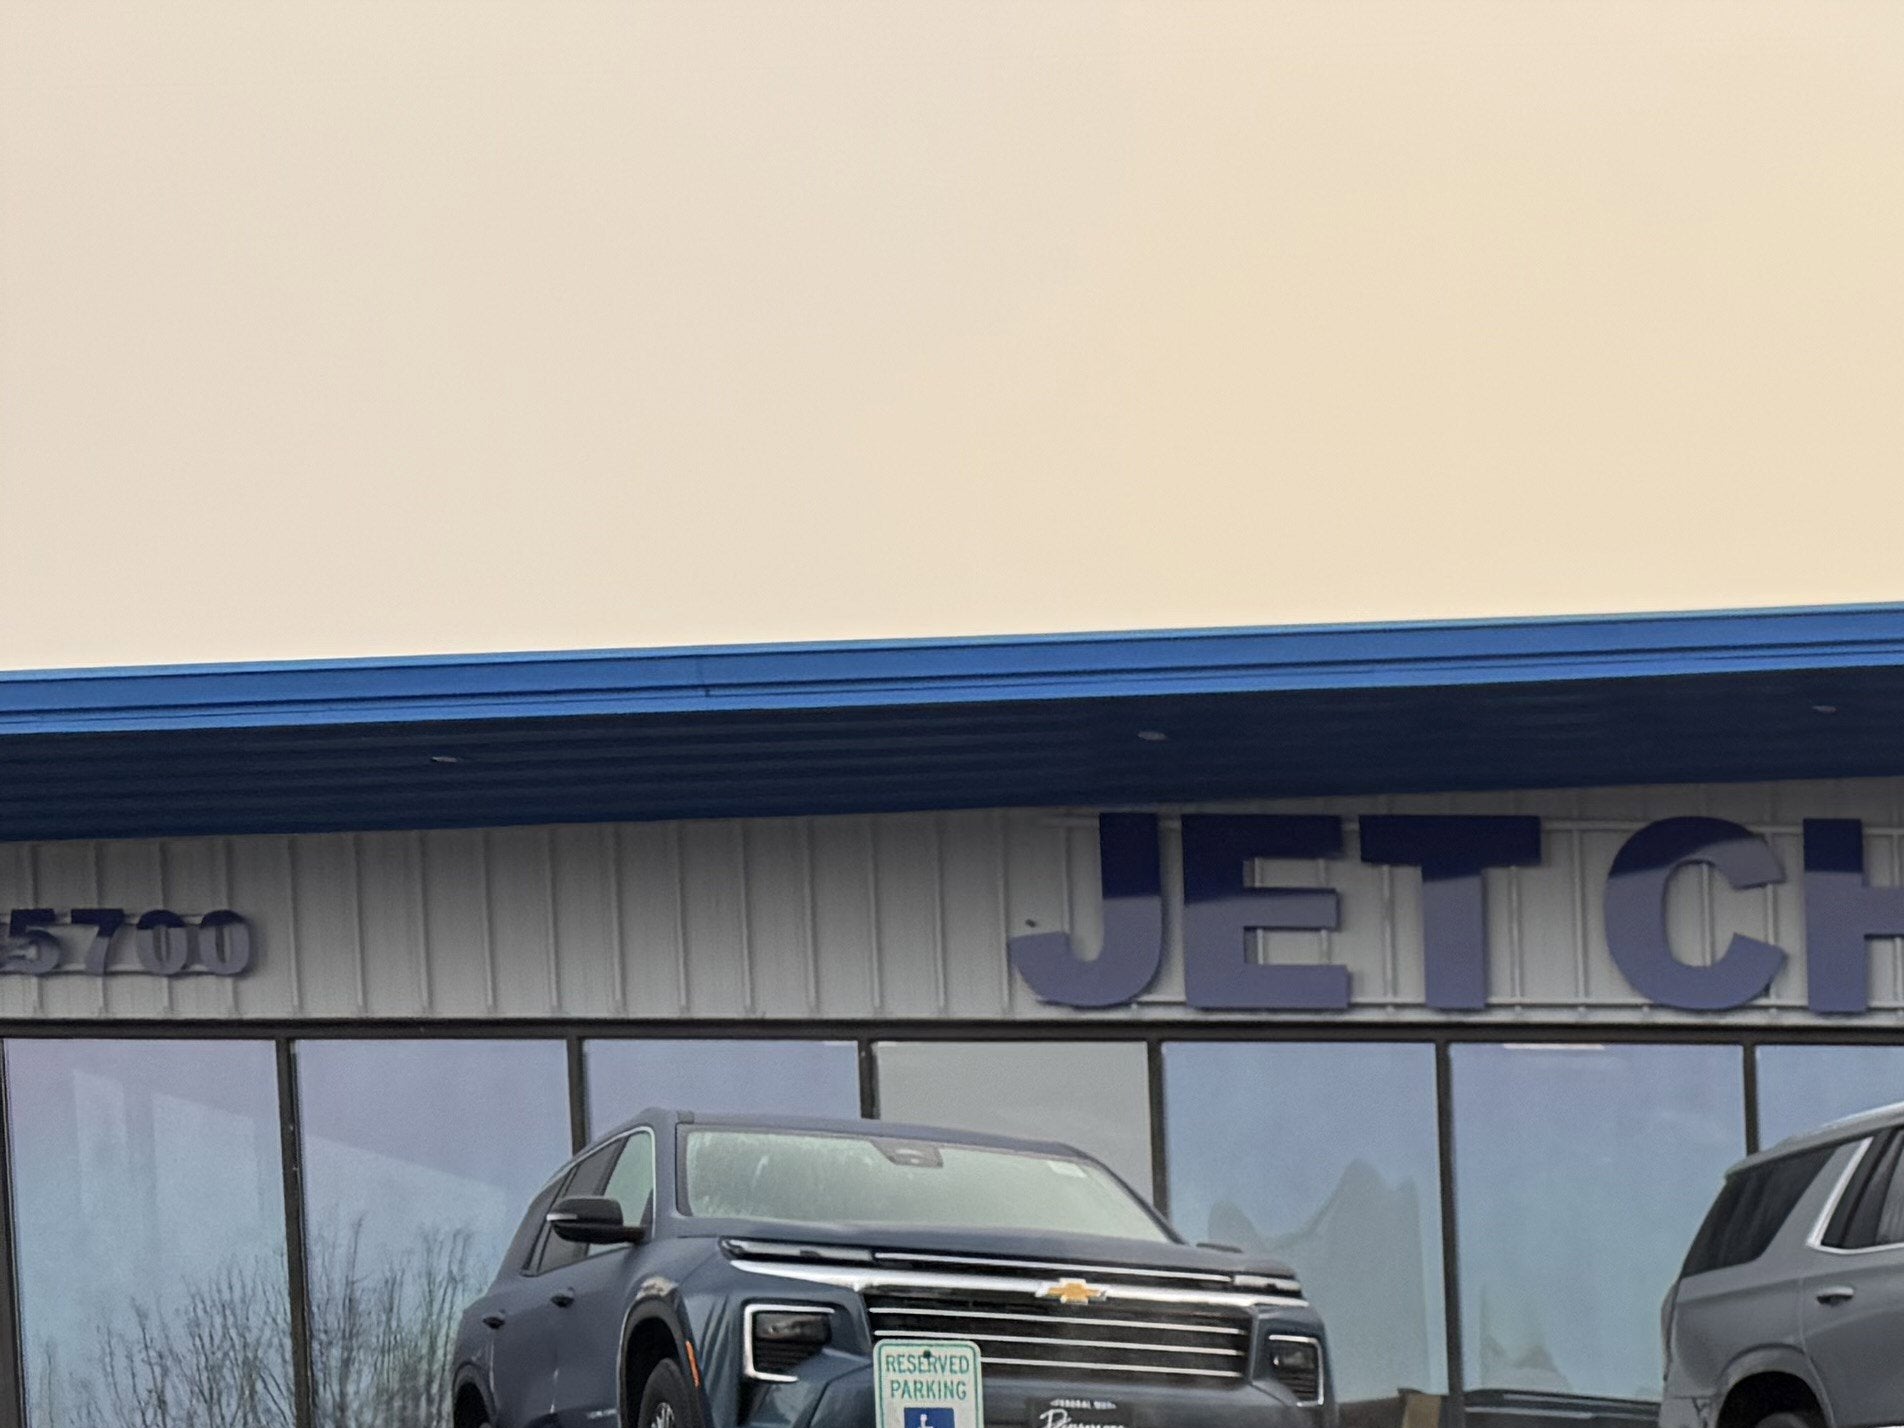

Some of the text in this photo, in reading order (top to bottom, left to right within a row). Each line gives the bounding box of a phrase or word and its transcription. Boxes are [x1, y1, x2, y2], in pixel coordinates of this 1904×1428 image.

[1007, 812, 1542, 1009] JET
[0, 908, 251, 976] 5700
[886, 1354, 970, 1375] RESERVED
[890, 1379, 967, 1400] PARKING
